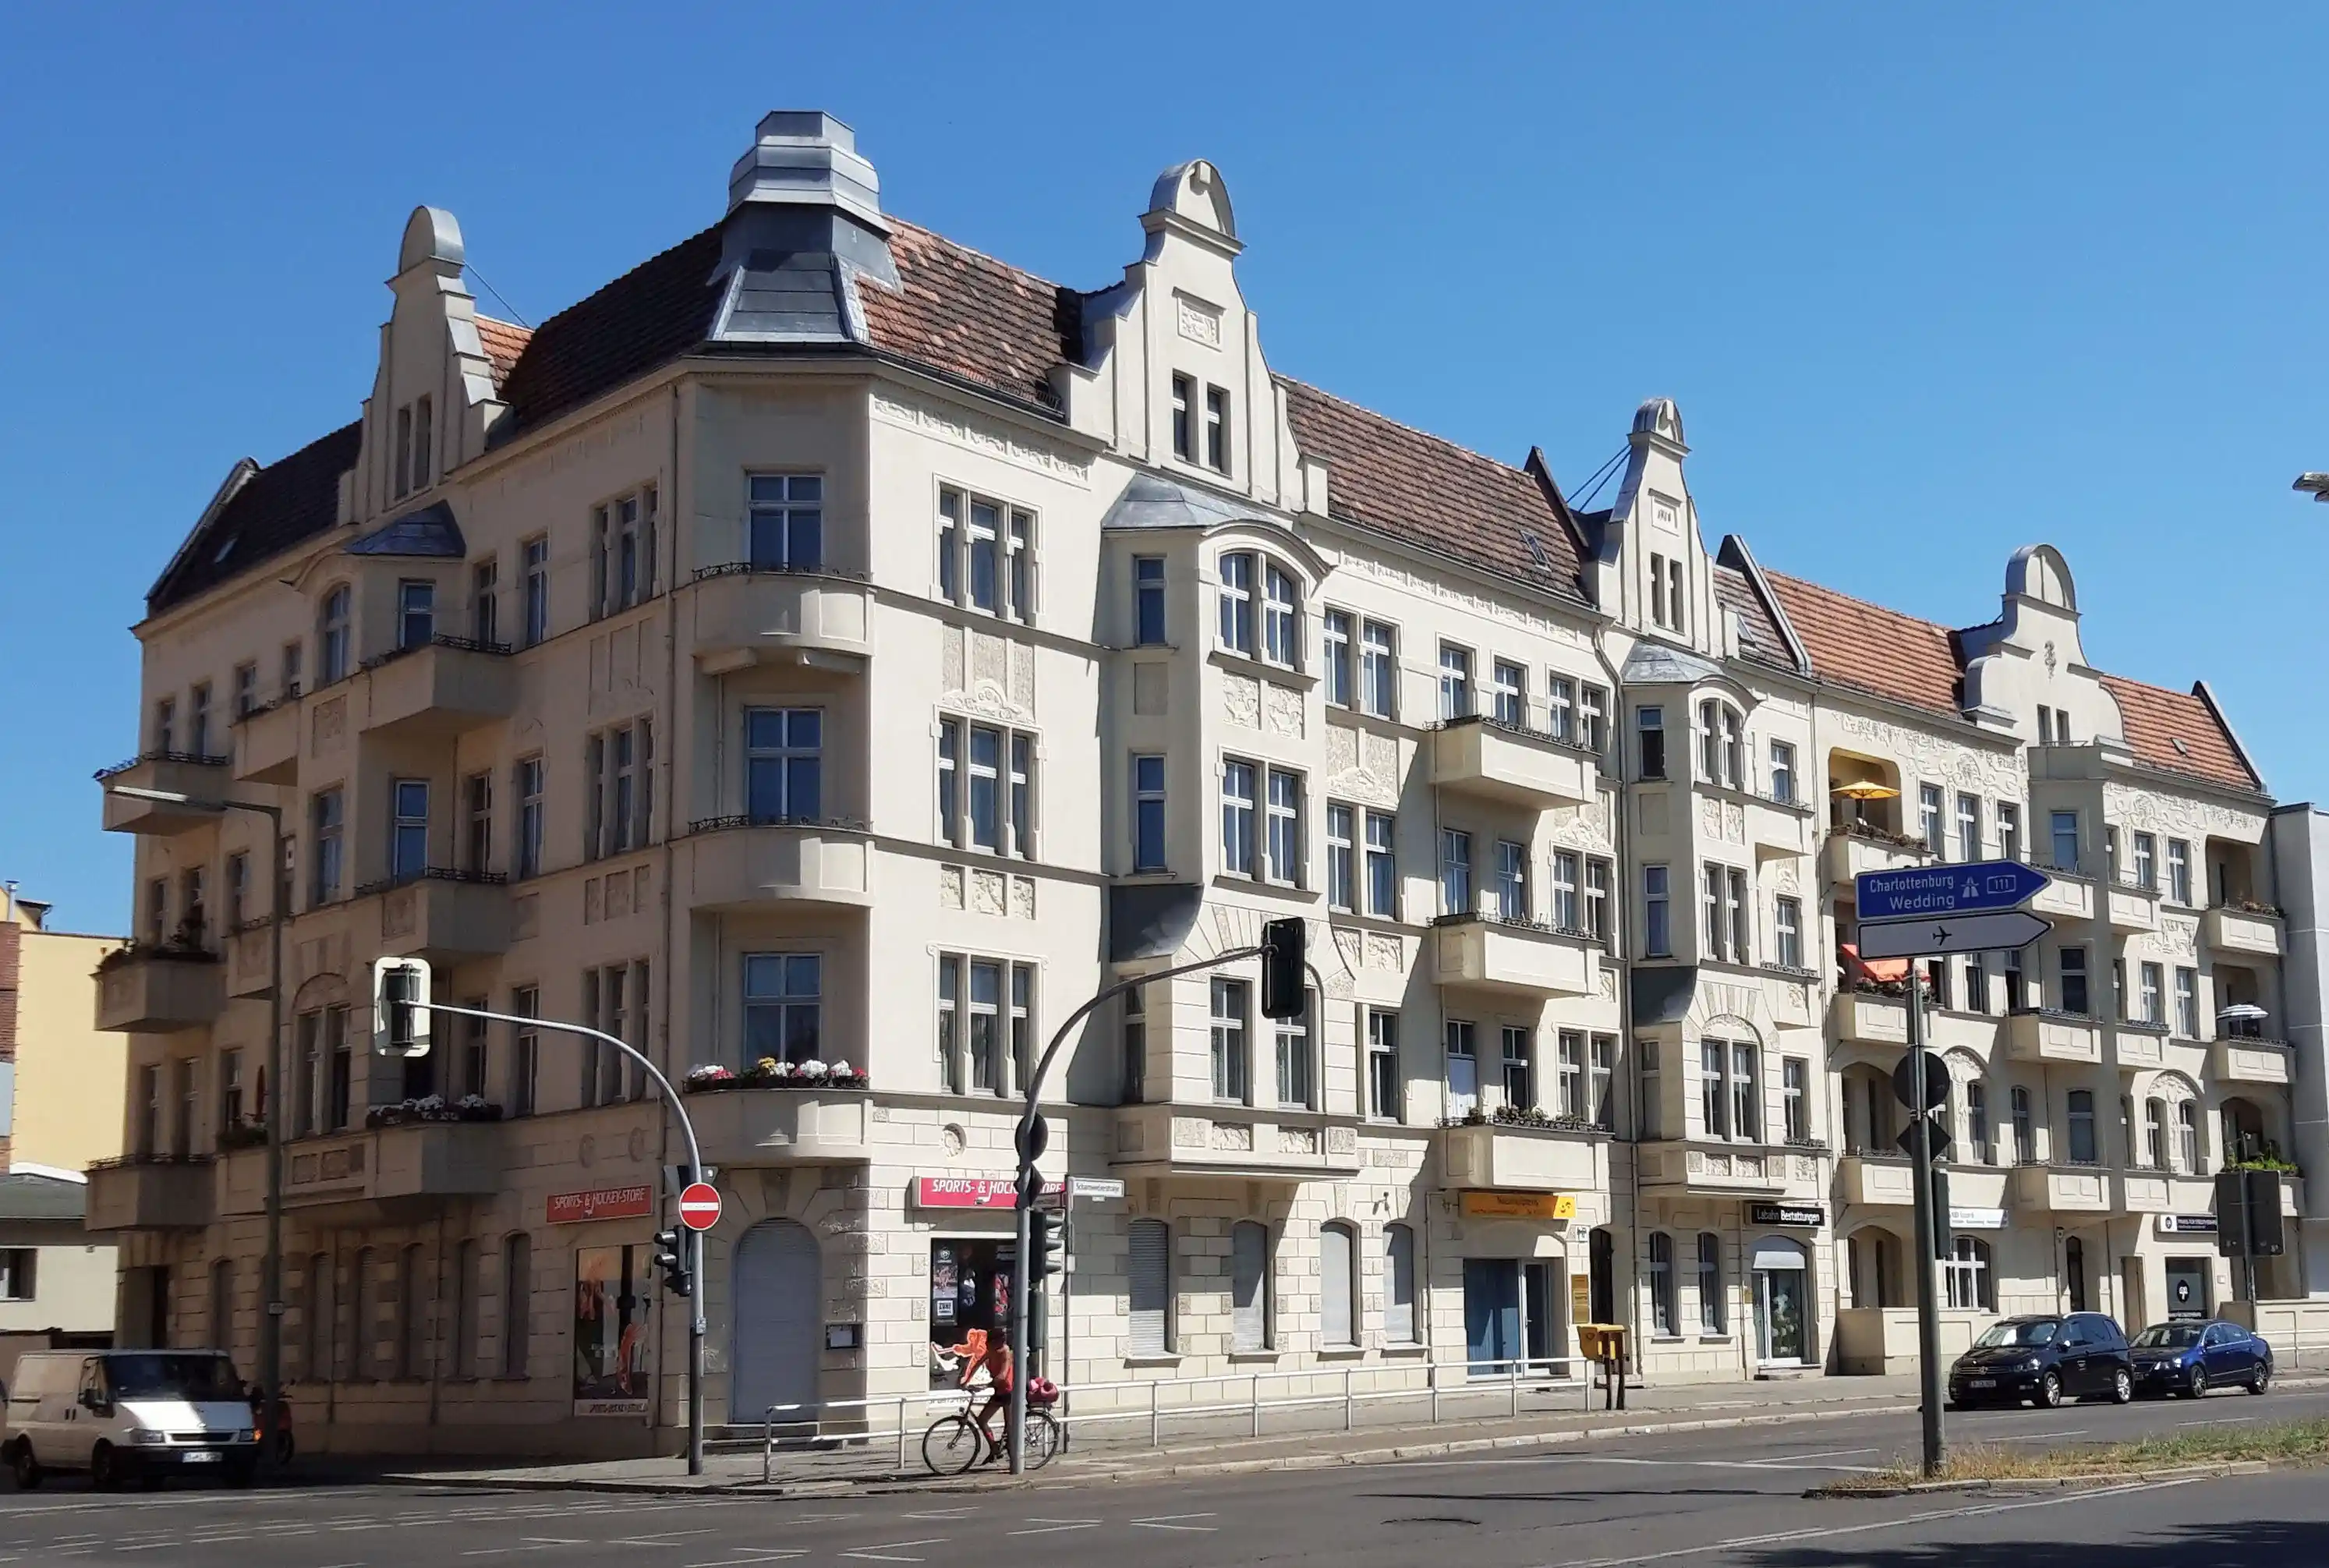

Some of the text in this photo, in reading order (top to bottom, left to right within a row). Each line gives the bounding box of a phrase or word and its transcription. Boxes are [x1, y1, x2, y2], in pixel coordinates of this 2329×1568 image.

[1870, 875, 2009, 894] Charlottenburg 111
[1889, 894, 1955, 910] Wedding
[933, 1179, 975, 1194] SPORTS-
[978, 1180, 986, 1194] &
[1780, 1209, 1820, 1225] Bestattungen
